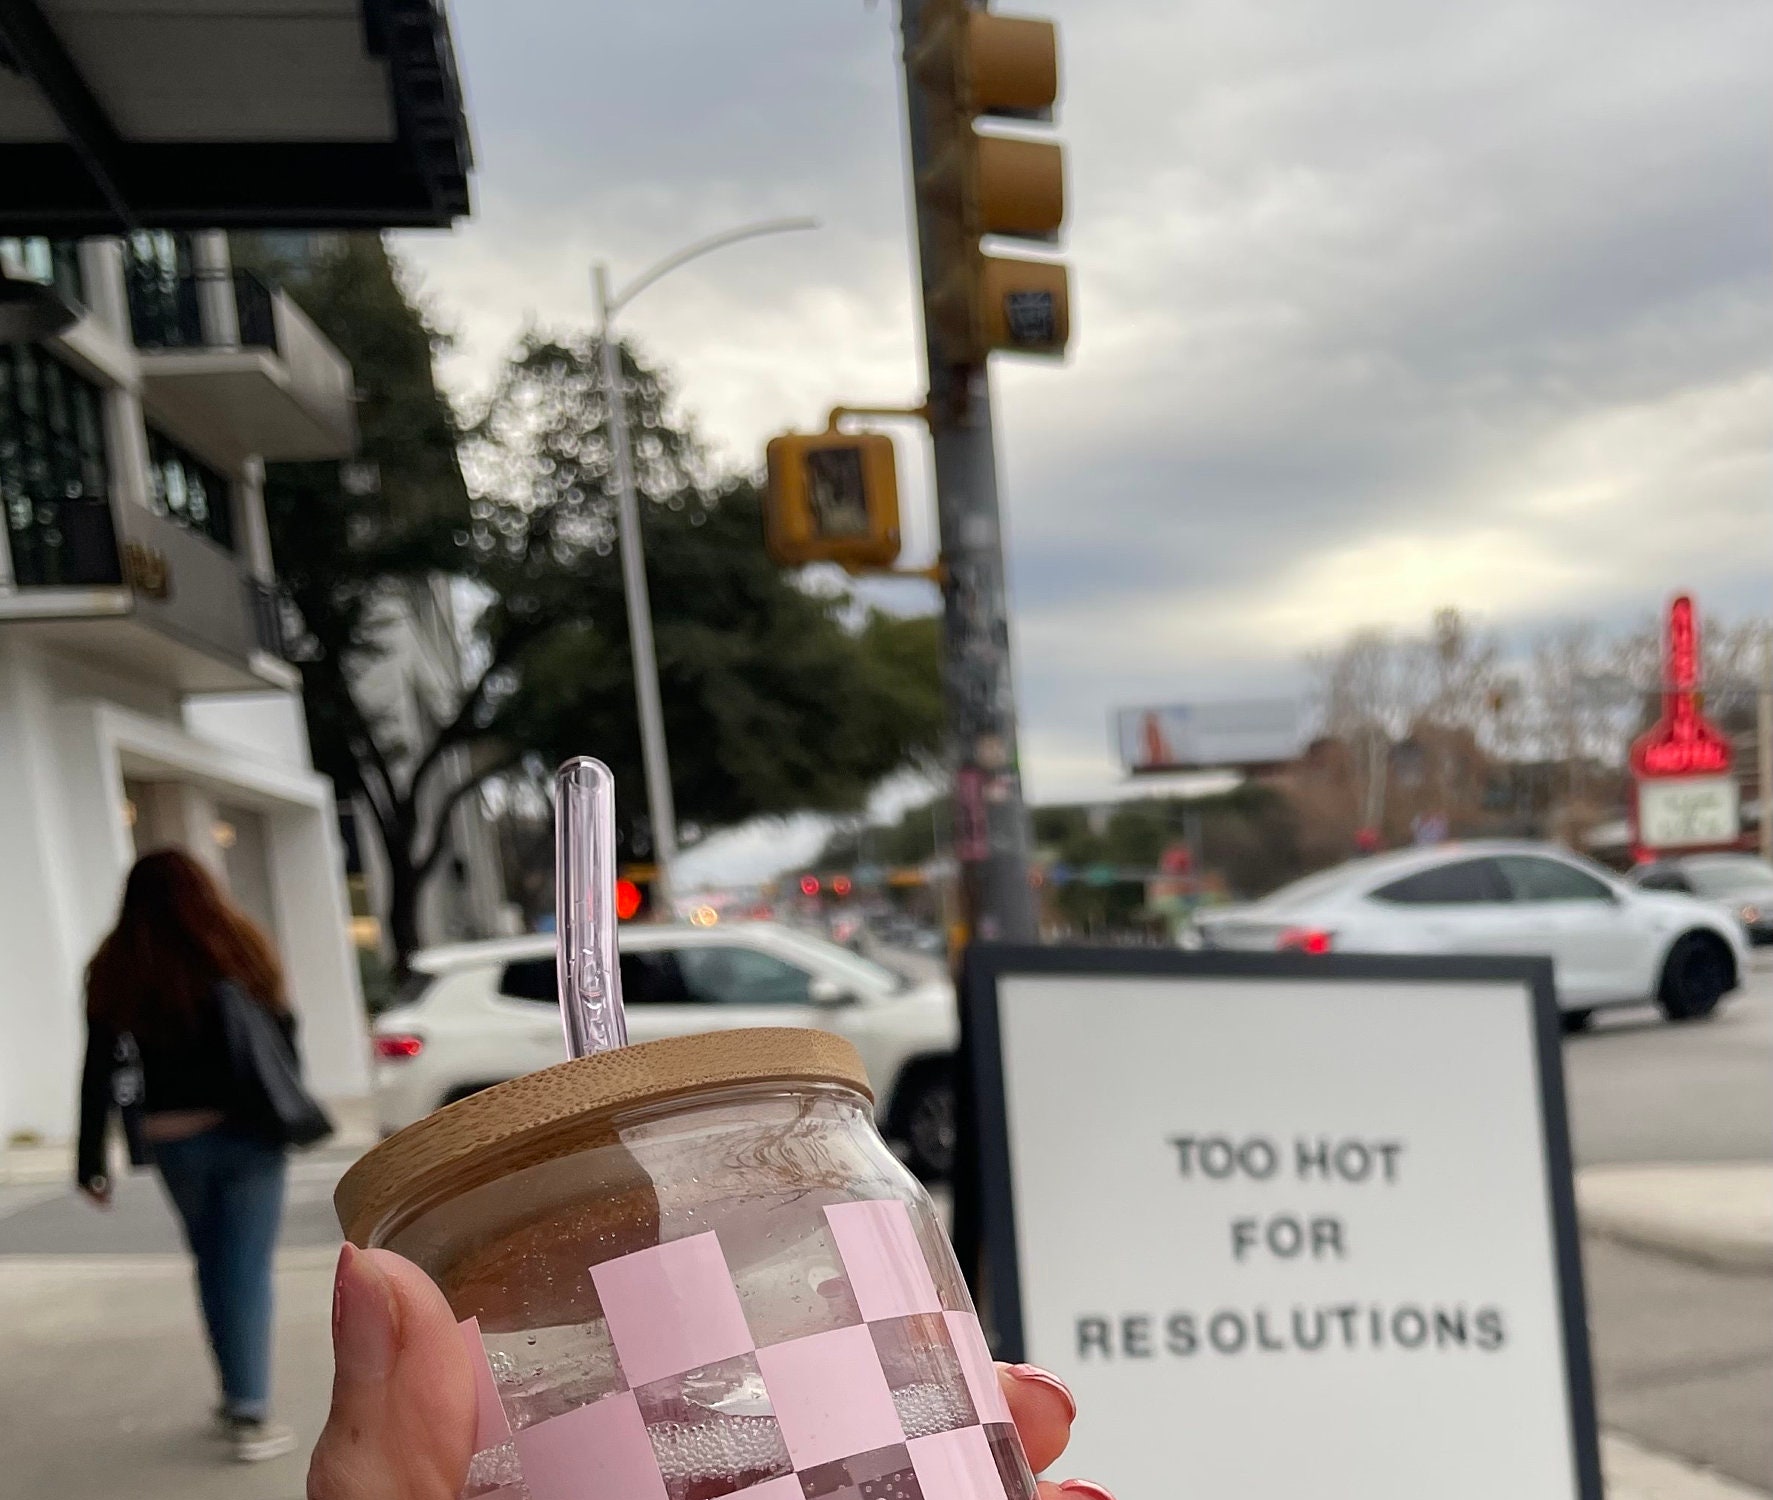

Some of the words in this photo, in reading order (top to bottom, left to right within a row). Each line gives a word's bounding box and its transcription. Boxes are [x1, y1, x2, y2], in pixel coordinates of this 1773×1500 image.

[1168, 1136, 1278, 1180] TOO
[1295, 1140, 1402, 1182] HOT
[1231, 1217, 1344, 1260] FOR
[1075, 1306, 1506, 1359] RESOLUTIONS
